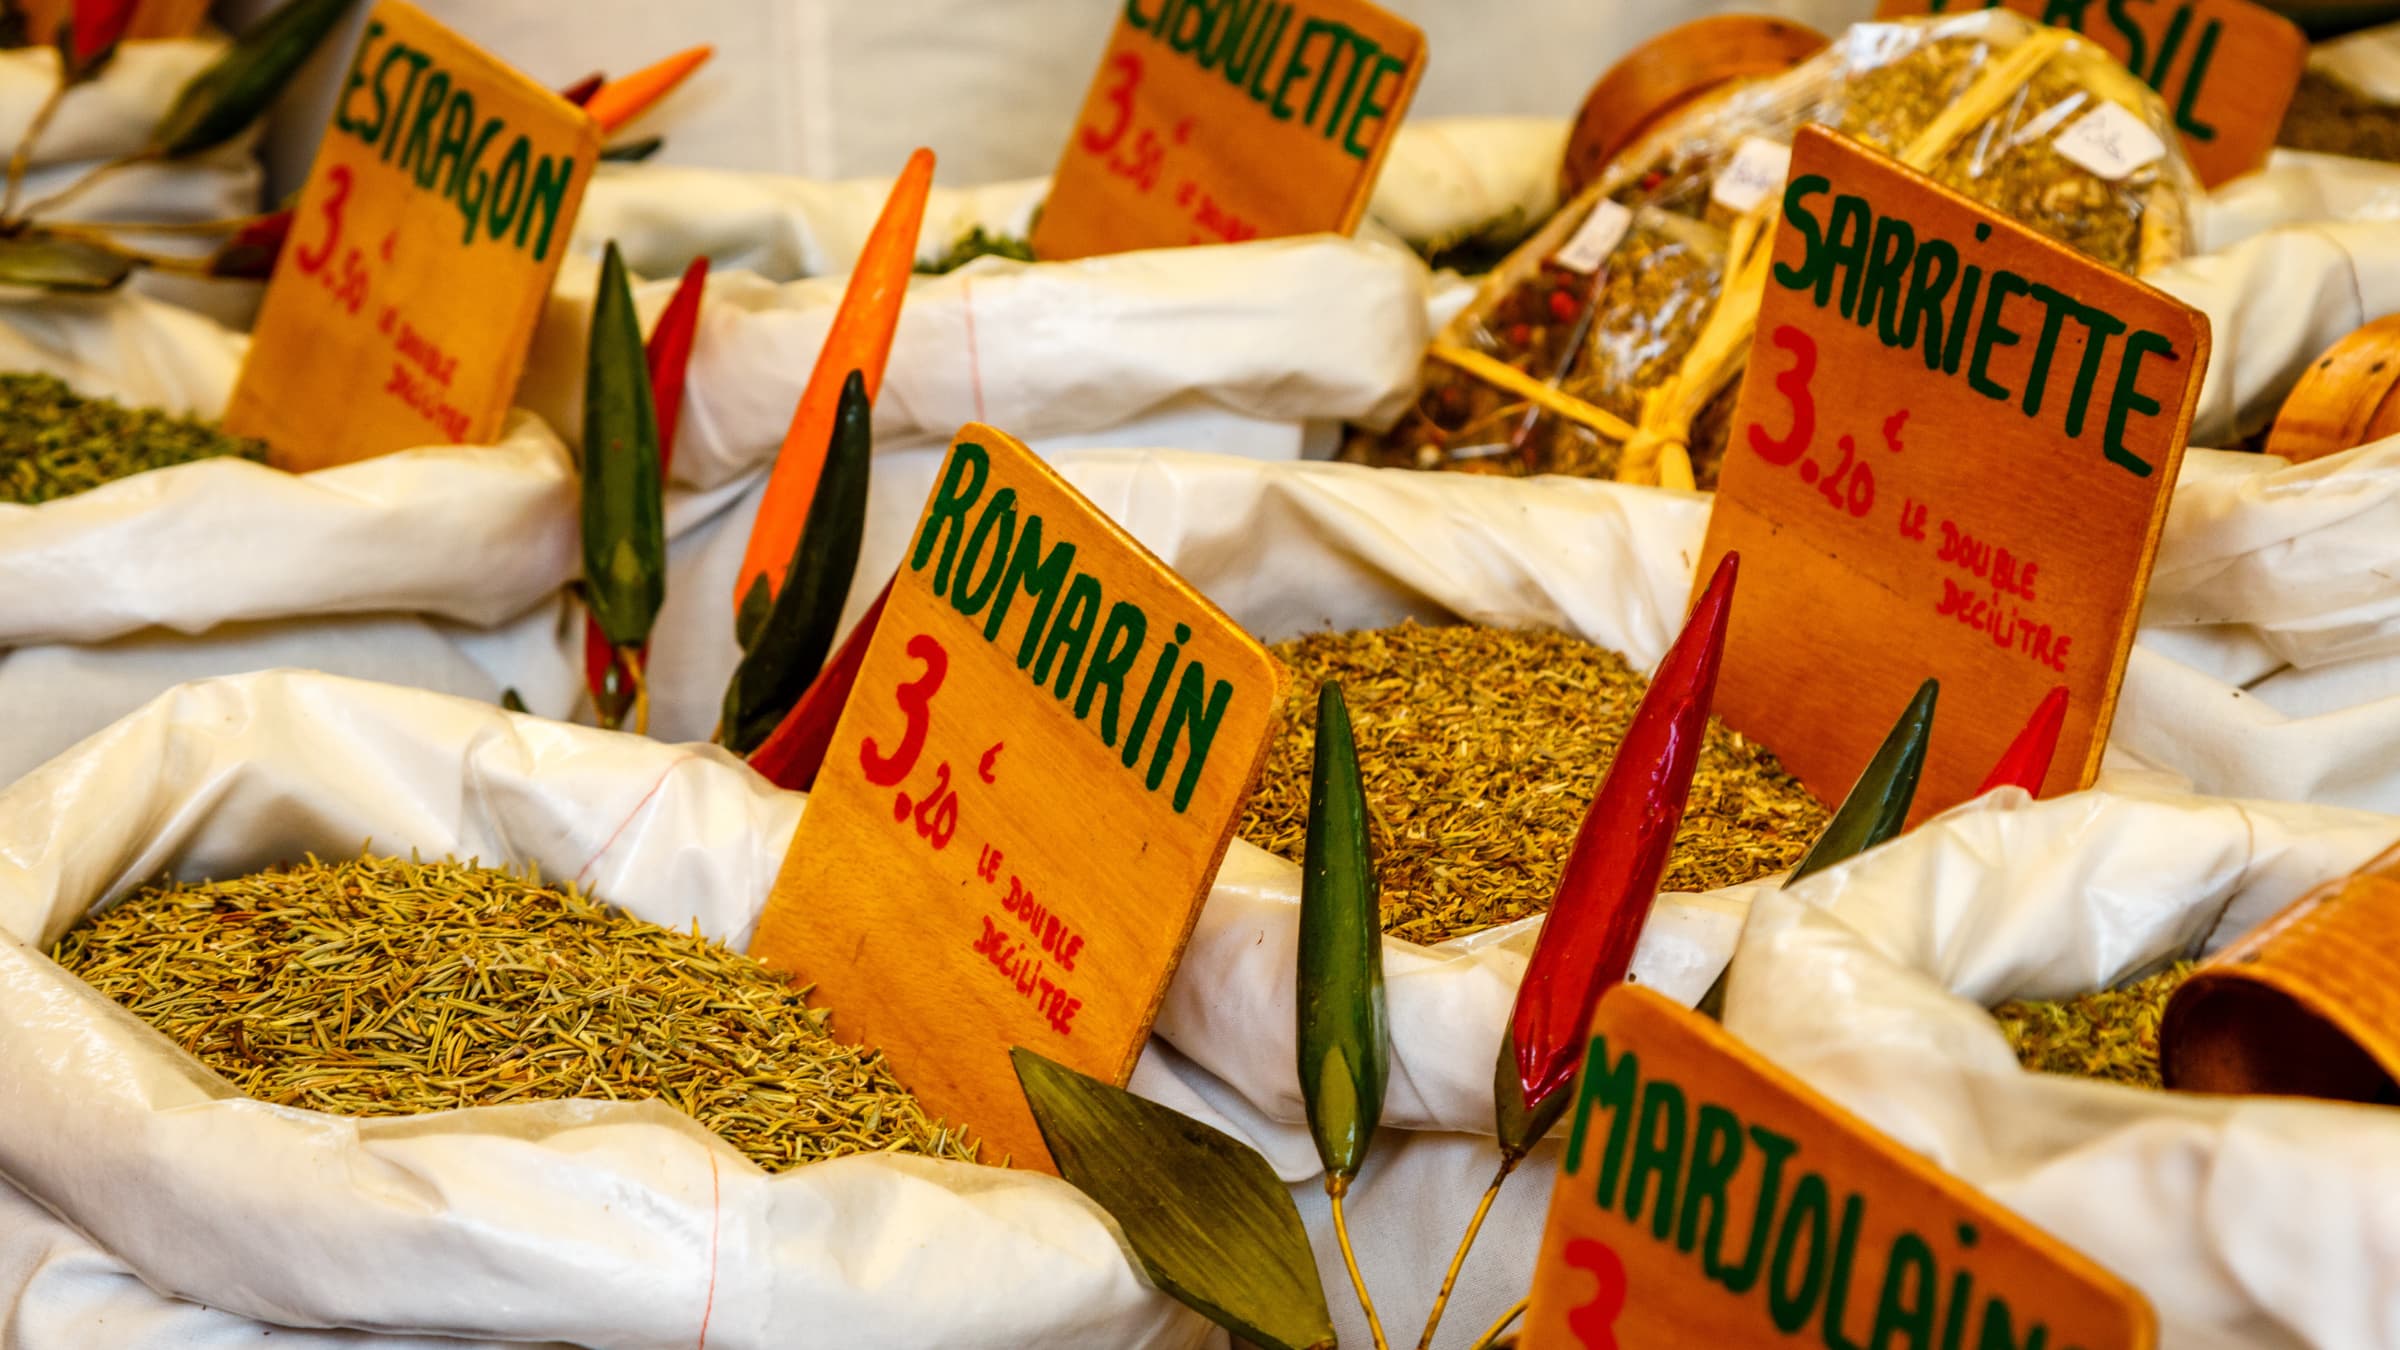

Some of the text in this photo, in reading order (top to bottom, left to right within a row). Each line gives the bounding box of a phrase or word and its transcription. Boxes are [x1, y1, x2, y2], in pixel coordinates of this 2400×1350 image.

[335, 22, 574, 263] ESTRAGON
[295, 163, 369, 315] 3.50
[1747, 323, 1876, 519] 3.20
[1898, 496, 2041, 603] LE DOUBLE
[859, 633, 958, 850] 3.20
[977, 842, 1086, 973] LE DOUBLE
